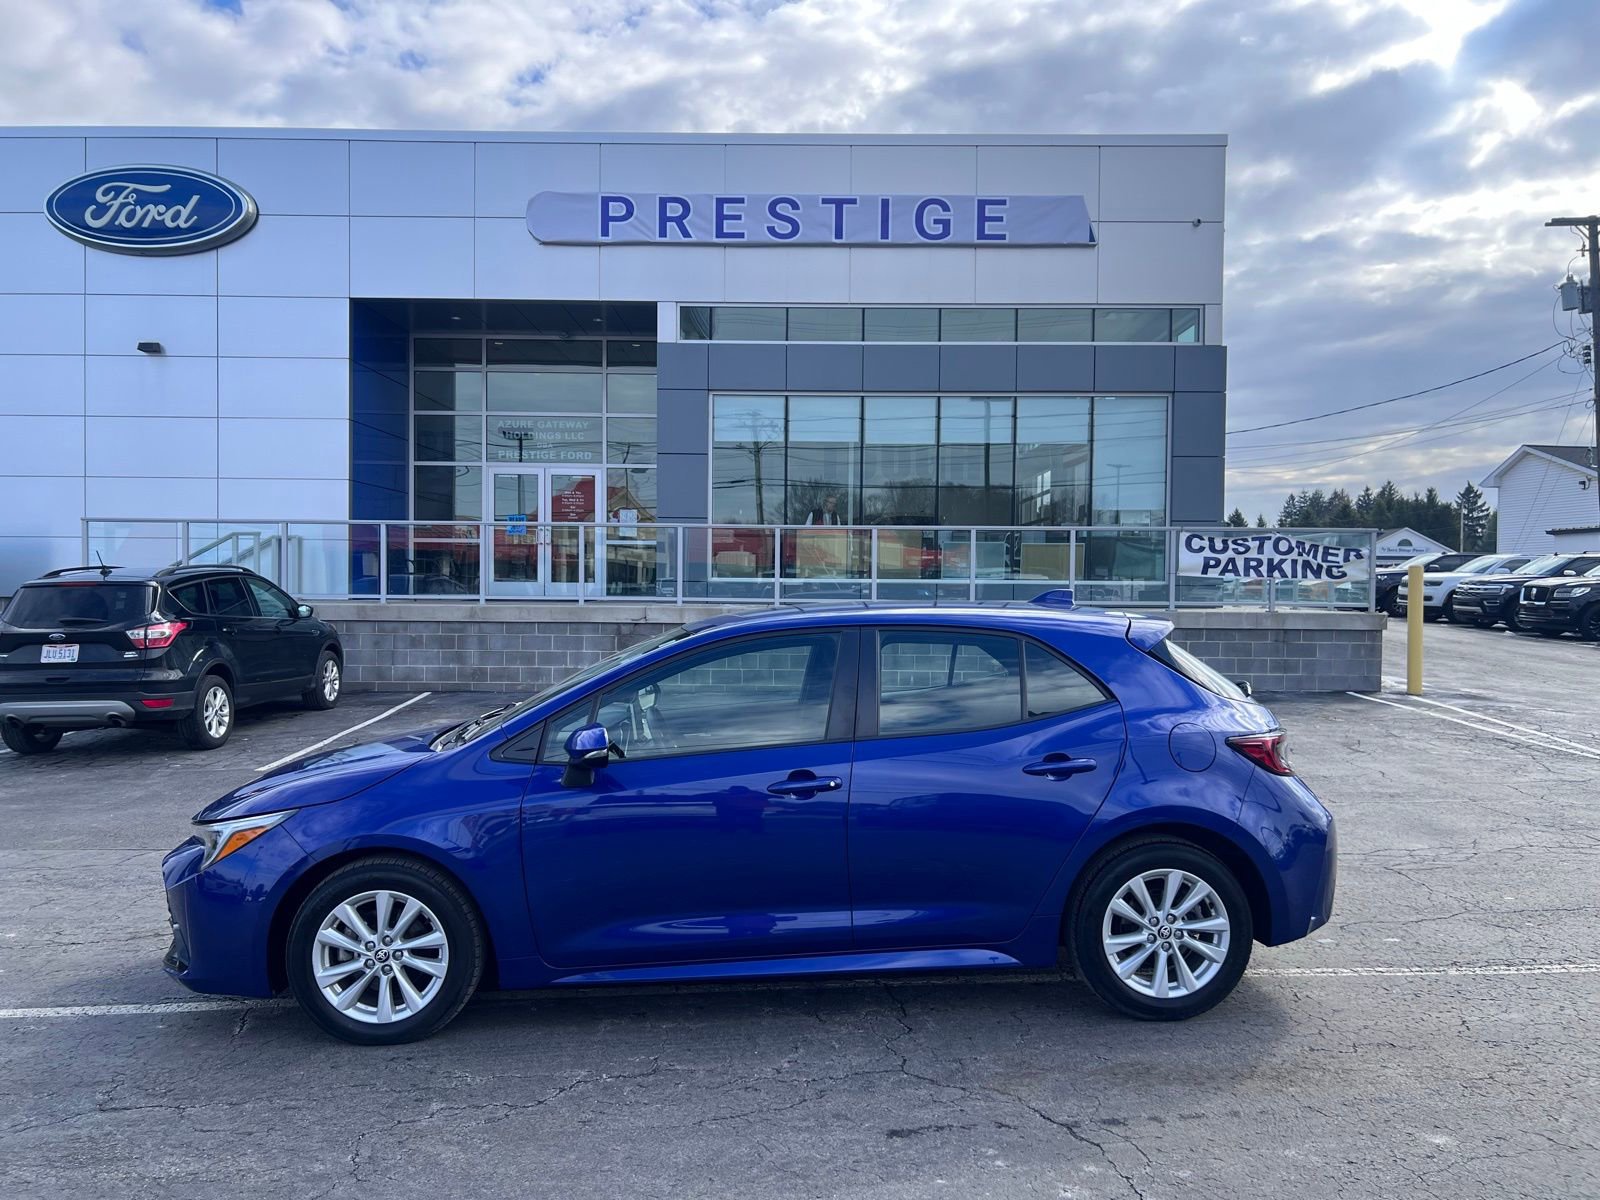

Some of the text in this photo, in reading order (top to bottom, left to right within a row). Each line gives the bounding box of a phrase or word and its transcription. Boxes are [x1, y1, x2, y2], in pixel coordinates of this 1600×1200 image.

[84, 181, 200, 229] Ford
[600, 195, 1007, 241] PRESTIGE
[498, 420, 589, 429] AZURE GATEWAY
[505, 431, 585, 440] HOLDINGS LLC
[498, 450, 593, 460] PRESTIGE FORD
[1184, 533, 1365, 564] CUSTOMER
[1201, 556, 1348, 580] PARKING
